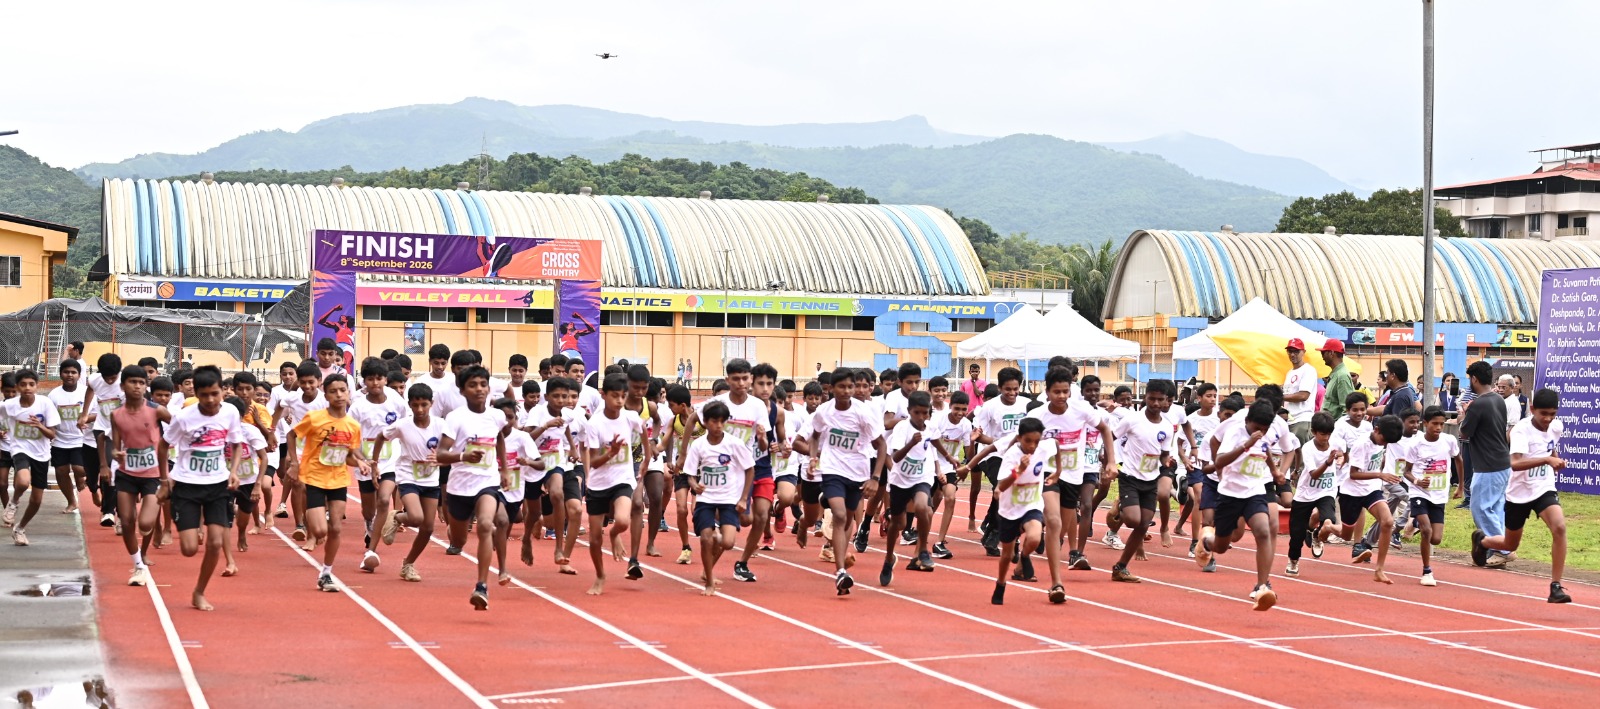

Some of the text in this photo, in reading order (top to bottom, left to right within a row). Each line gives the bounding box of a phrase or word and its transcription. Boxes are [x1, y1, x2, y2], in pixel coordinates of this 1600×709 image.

[341, 234, 434, 259] FINISH
[409, 261, 433, 269] 2026
[542, 251, 580, 268] CROSS
[541, 268, 580, 277] COUNTRY
[194, 286, 294, 299] BASKETB
[379, 291, 507, 303] VOLLEY BALL
[1552, 294, 1560, 303] Dr.
[1562, 292, 1580, 303] Satish
[600, 296, 672, 307] NASTICS
[716, 299, 840, 311] TABLE TENNIS
[1550, 307, 1597, 320] Deshpande, Dr.
[1550, 323, 1567, 335] Sujata
[1588, 322, 1596, 332] Dr.
[1548, 338, 1556, 348] Dr.
[1558, 338, 1576, 348] Rohini
[1546, 368, 1578, 380] Gurukrupa
[1564, 383, 1589, 393] Rohinee
[1562, 399, 1593, 410] Stationers,
[62, 407, 79, 419] 321
[1003, 419, 1019, 431] 075
[18, 424, 40, 439] 333
[829, 433, 856, 450] 0747
[1564, 444, 1588, 455] Neelam
[127, 453, 155, 468] 0748
[189, 457, 219, 473] 0780
[1085, 453, 1100, 465] 784
[1528, 464, 1546, 477] 078
[703, 472, 727, 487] 0773
[1309, 477, 1333, 489] 0768
[1560, 476, 1583, 487] Bendre,
[1017, 486, 1037, 503] 327
